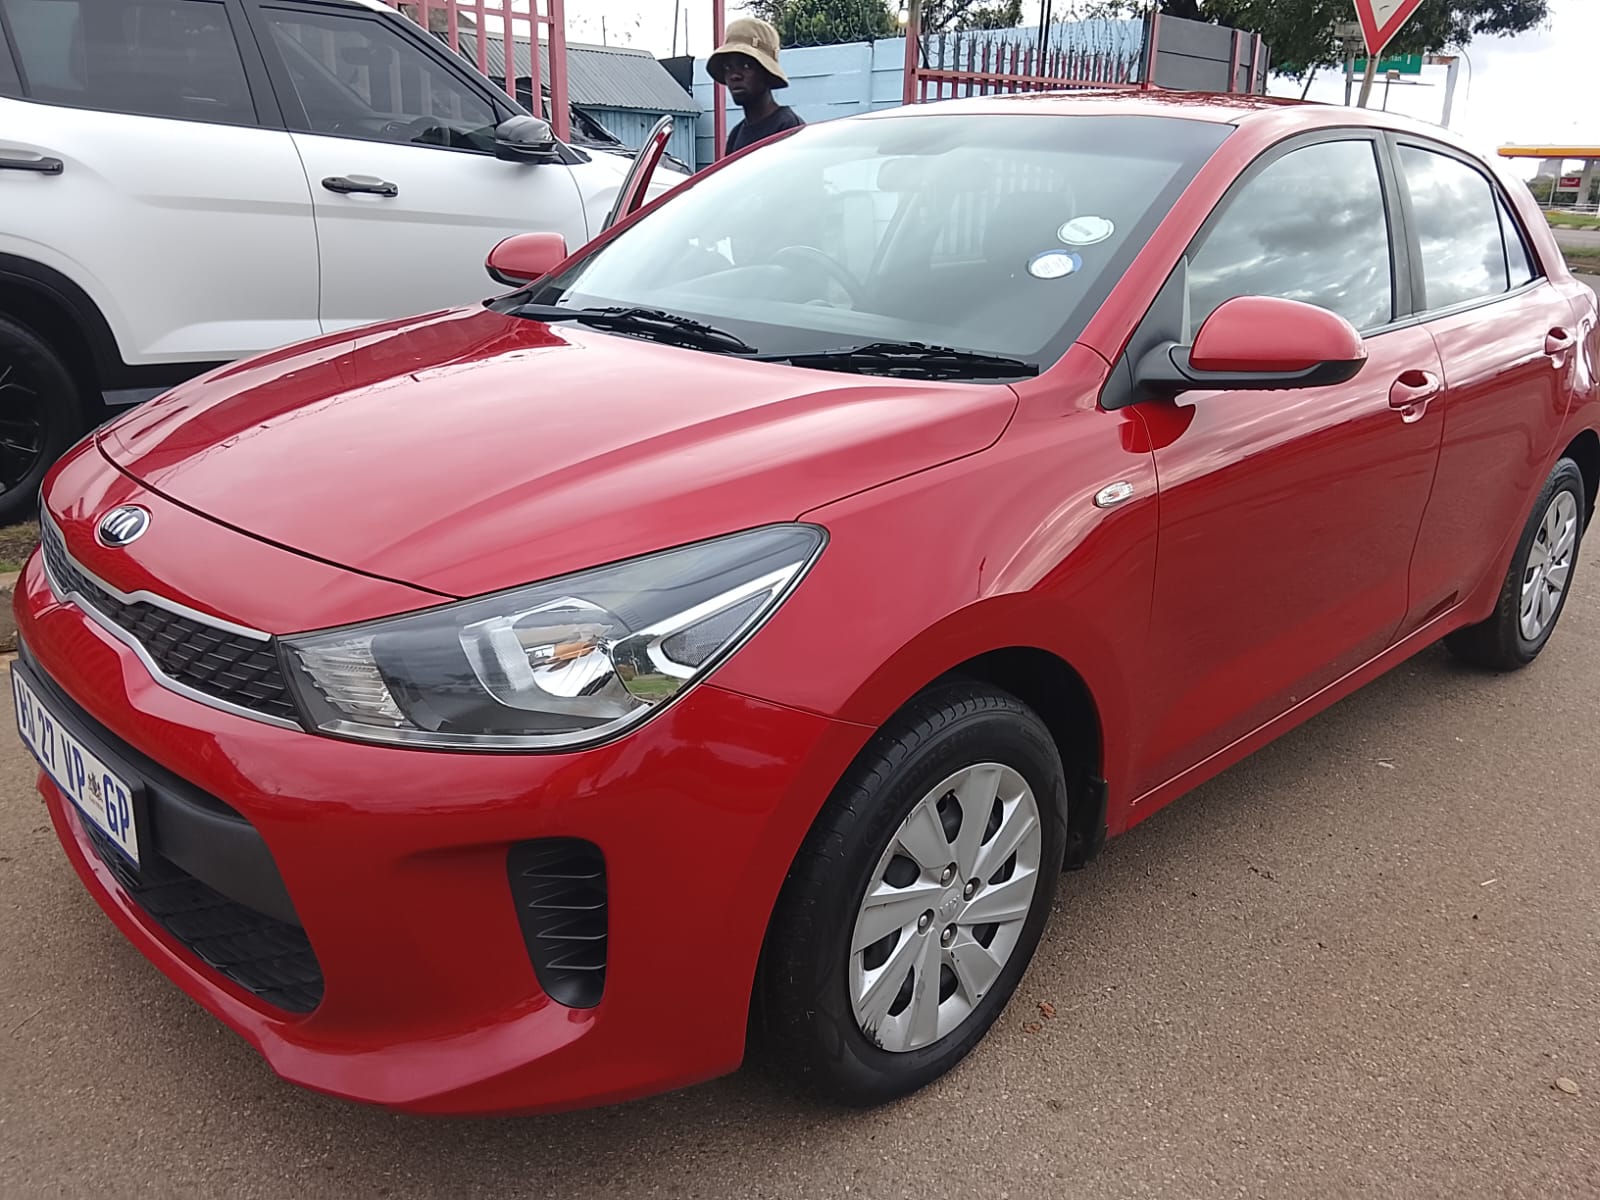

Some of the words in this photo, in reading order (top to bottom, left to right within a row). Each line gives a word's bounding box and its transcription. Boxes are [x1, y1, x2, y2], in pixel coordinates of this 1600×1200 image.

[102, 508, 139, 540] KIA
[38, 706, 56, 771] 27
[61, 732, 86, 801] VP
[102, 772, 130, 843] GP
